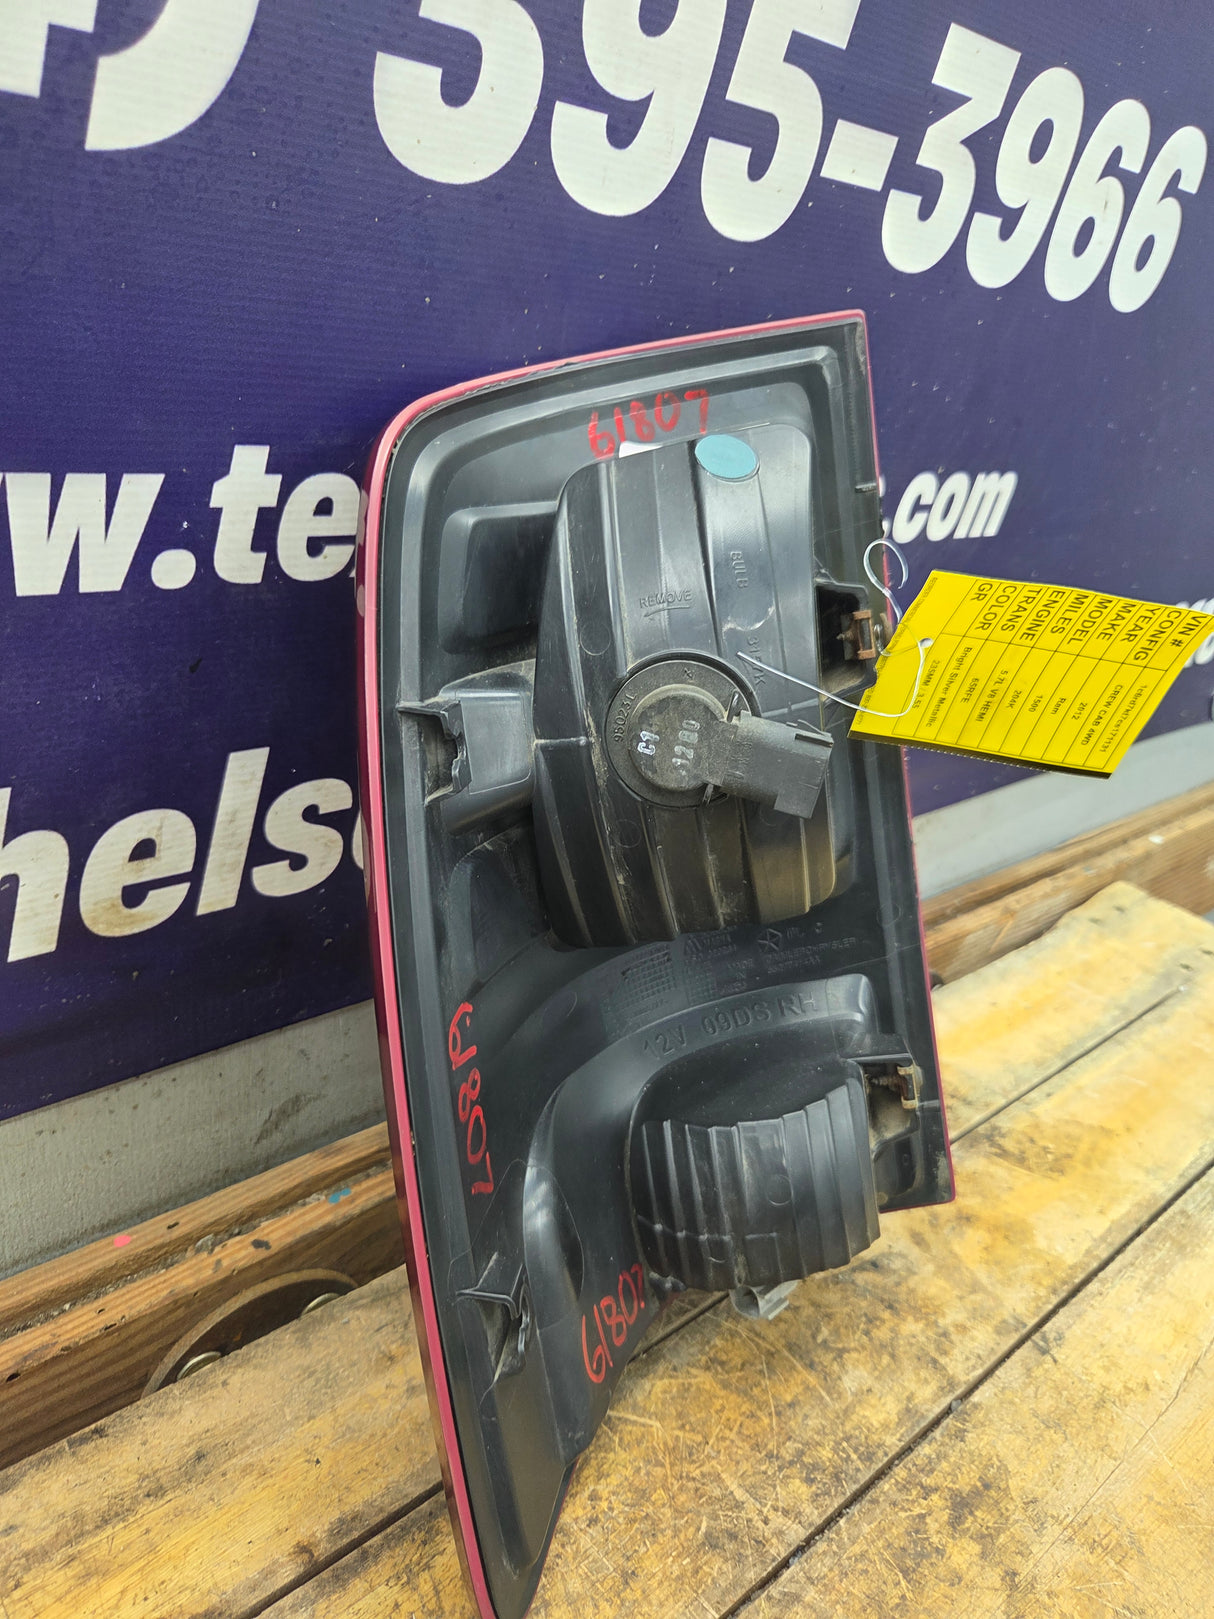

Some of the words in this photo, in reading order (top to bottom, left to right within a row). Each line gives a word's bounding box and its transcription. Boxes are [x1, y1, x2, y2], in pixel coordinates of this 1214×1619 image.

[588, 389, 709, 459] 61807
[639, 589, 693, 609] REMOVE
[970, 582, 993, 601] GR
[974, 585, 1017, 630] COLOR
[1000, 587, 1042, 631] TRANS
[1018, 589, 1066, 641] ENGINE
[1050, 593, 1089, 633] MILES
[1066, 598, 1113, 644] MODEL
[1095, 602, 1136, 640] MAKE
[1119, 607, 1161, 642] YEAR
[1177, 615, 1208, 636] VIN
[1133, 609, 1182, 660] CONFIG
[778, 992, 820, 1018] RH
